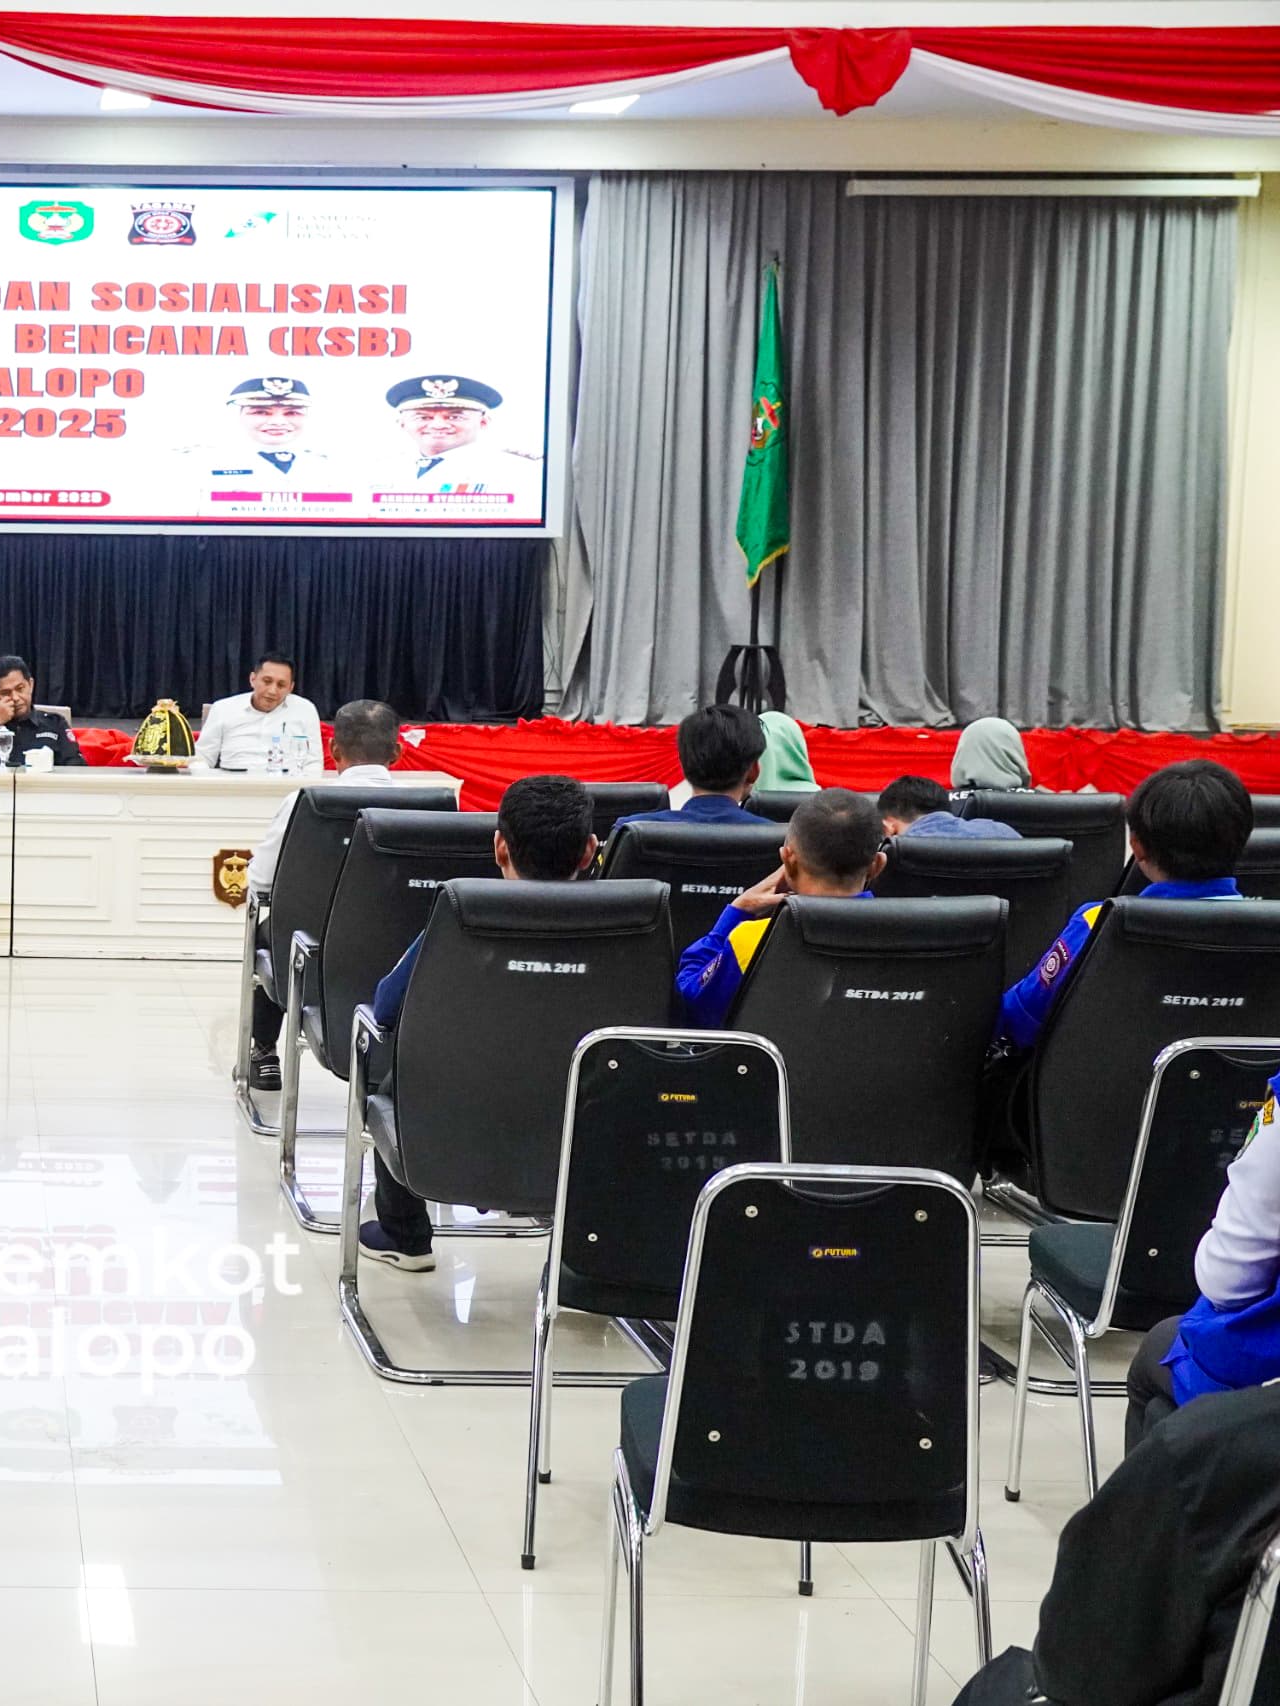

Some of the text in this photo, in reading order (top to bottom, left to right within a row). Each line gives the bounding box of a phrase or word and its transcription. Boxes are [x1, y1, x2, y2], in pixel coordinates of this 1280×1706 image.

[91, 283, 408, 314] SOSIALISASI
[15, 324, 249, 356] BENCANA
[268, 327, 412, 357] (KSB)
[408, 879, 438, 889] SETD
[784, 1320, 886, 1345] STDA
